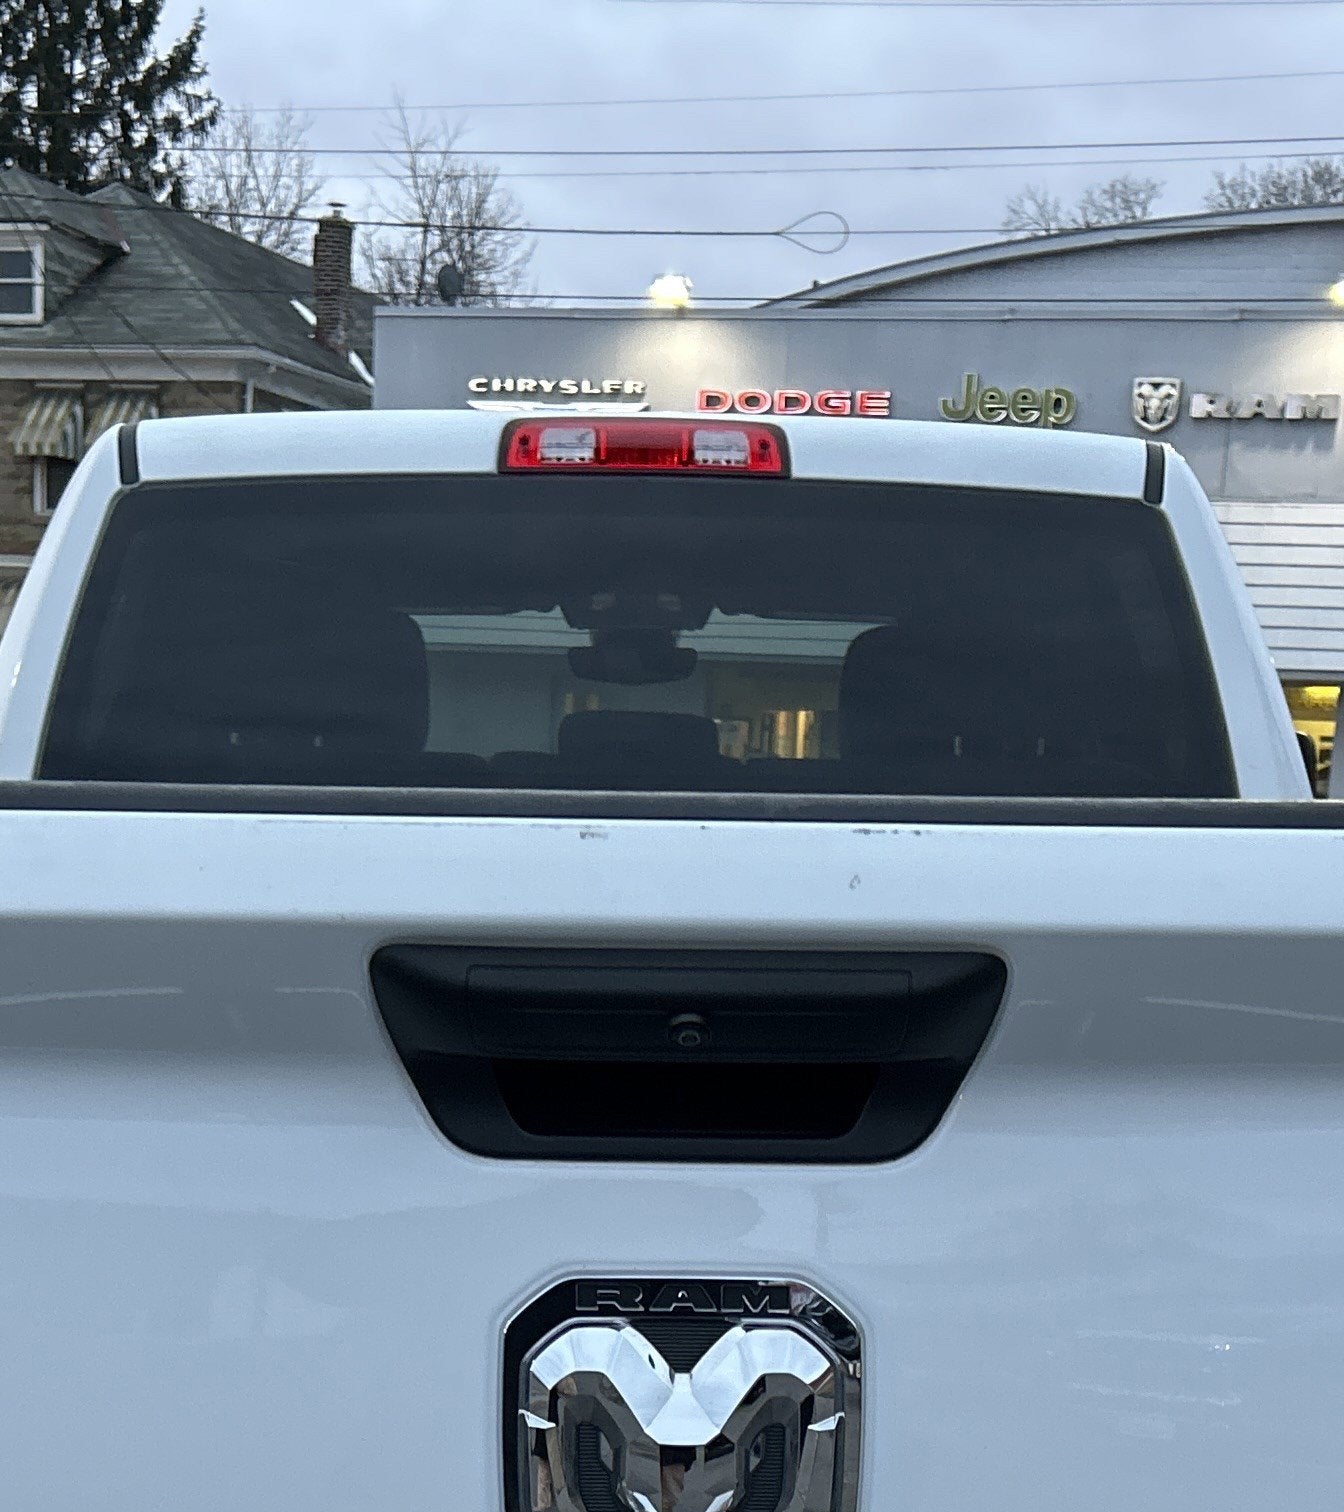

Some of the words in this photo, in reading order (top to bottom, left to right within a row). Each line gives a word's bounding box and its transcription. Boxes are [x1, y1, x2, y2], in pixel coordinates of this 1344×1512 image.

[467, 377, 647, 395] CHRYSLER
[939, 371, 1077, 427] Jeep
[697, 388, 891, 417] DODGE
[1188, 393, 1342, 419] RAM
[574, 1283, 791, 1315] RAM
